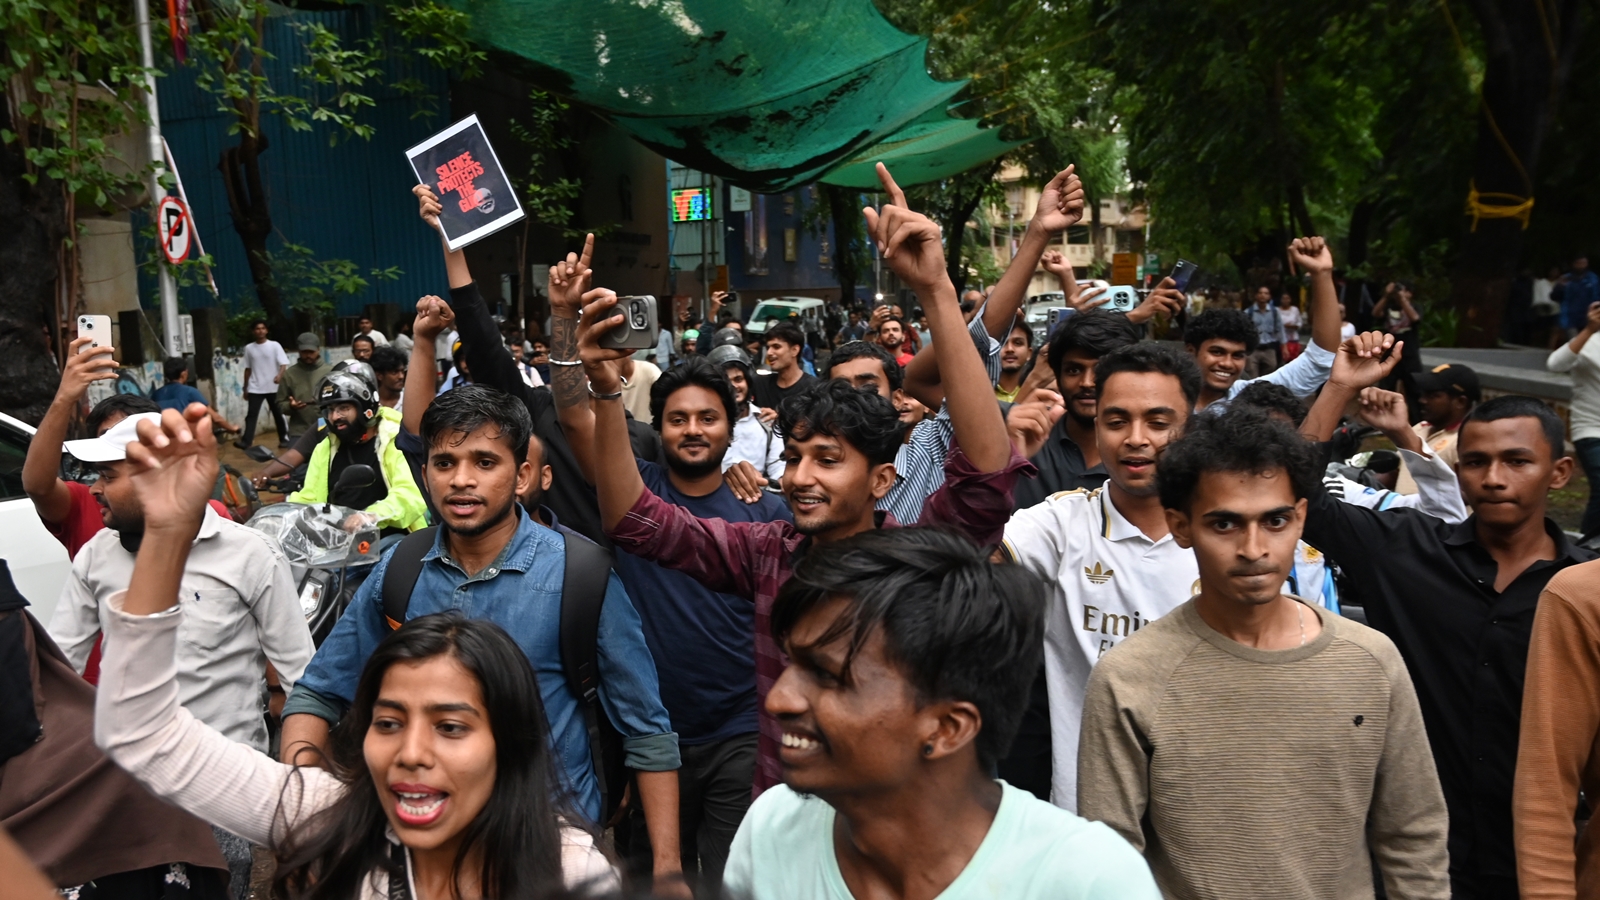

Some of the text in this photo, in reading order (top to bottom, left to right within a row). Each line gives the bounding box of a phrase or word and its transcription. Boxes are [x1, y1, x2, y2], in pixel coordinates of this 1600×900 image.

[436, 151, 474, 180] SILENCE
[437, 161, 484, 195] PROTECTS
[455, 180, 477, 200] THE
[165, 207, 183, 252] P
